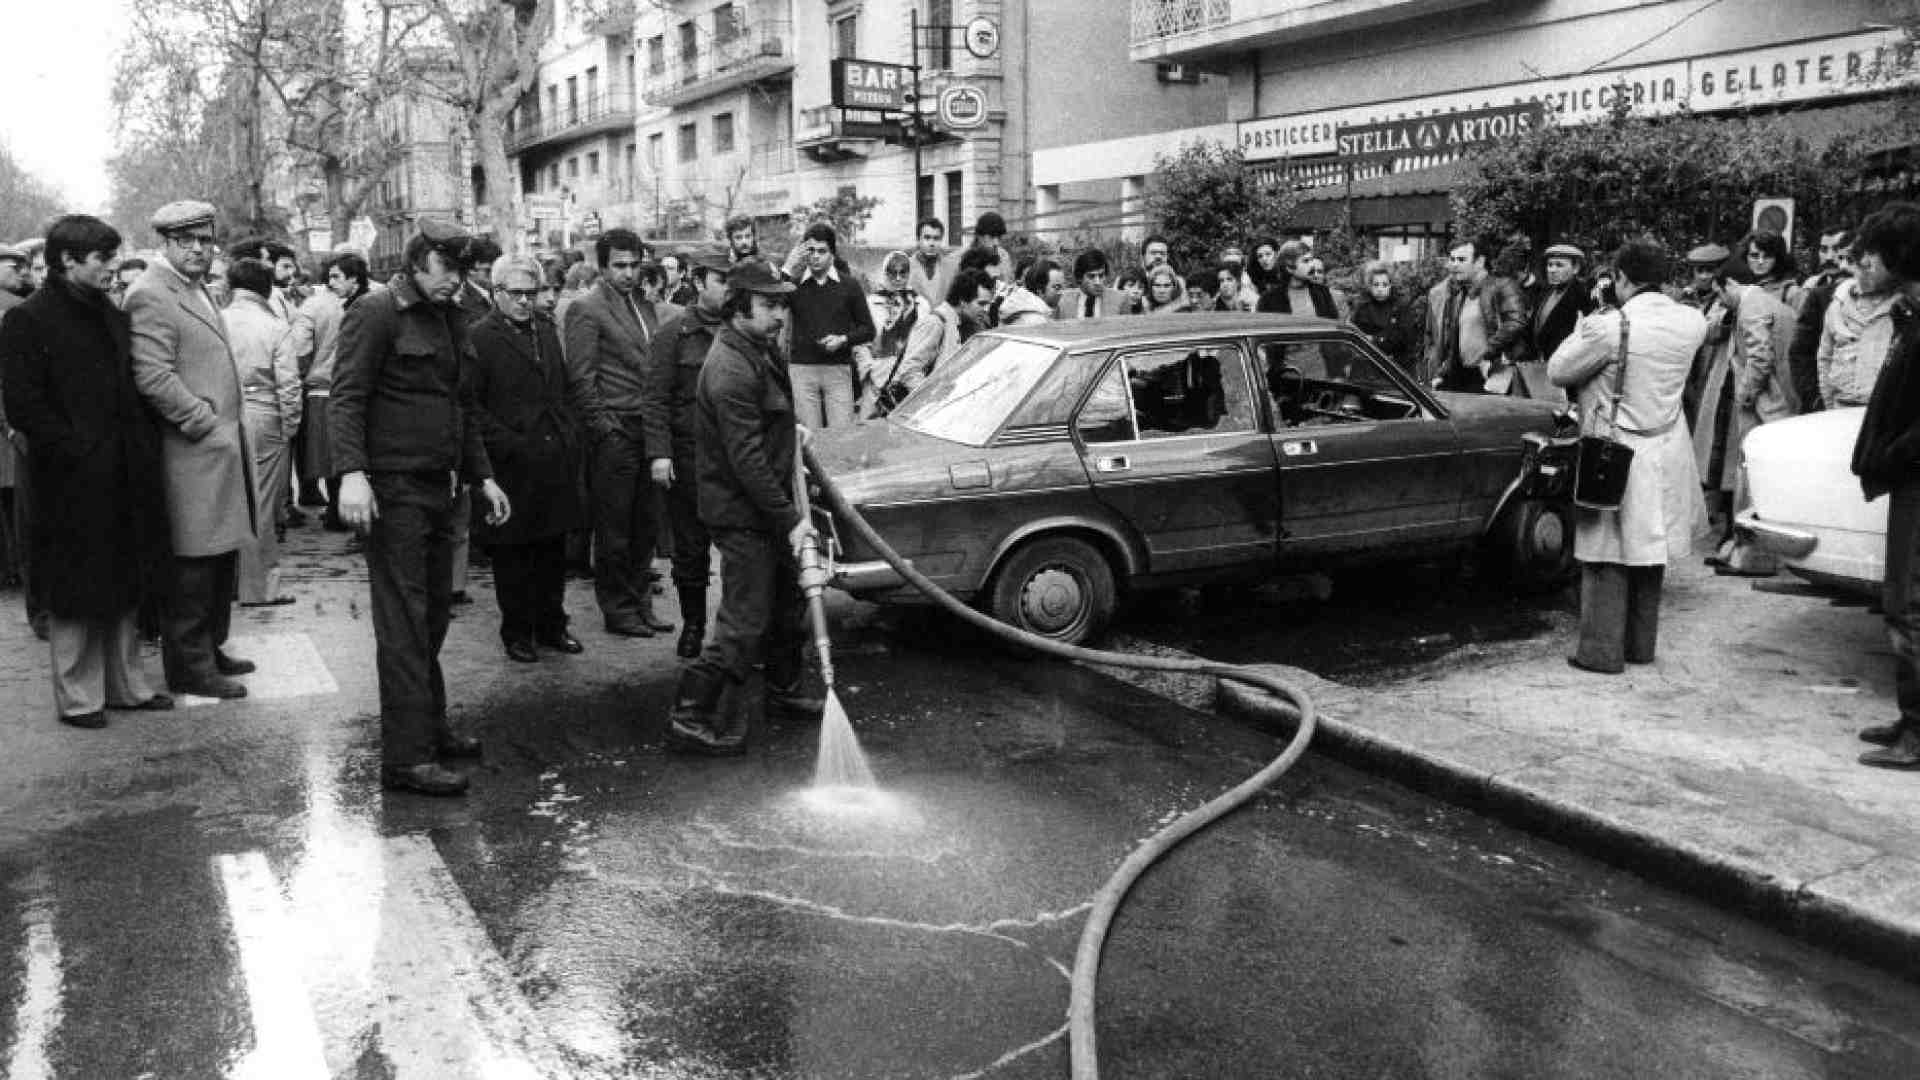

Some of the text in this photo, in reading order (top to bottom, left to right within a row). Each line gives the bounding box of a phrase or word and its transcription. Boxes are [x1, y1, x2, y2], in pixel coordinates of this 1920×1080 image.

[848, 66, 896, 89] BAR
[1339, 128, 1411, 155] STELLA
[1446, 112, 1530, 146] ARTOIS
